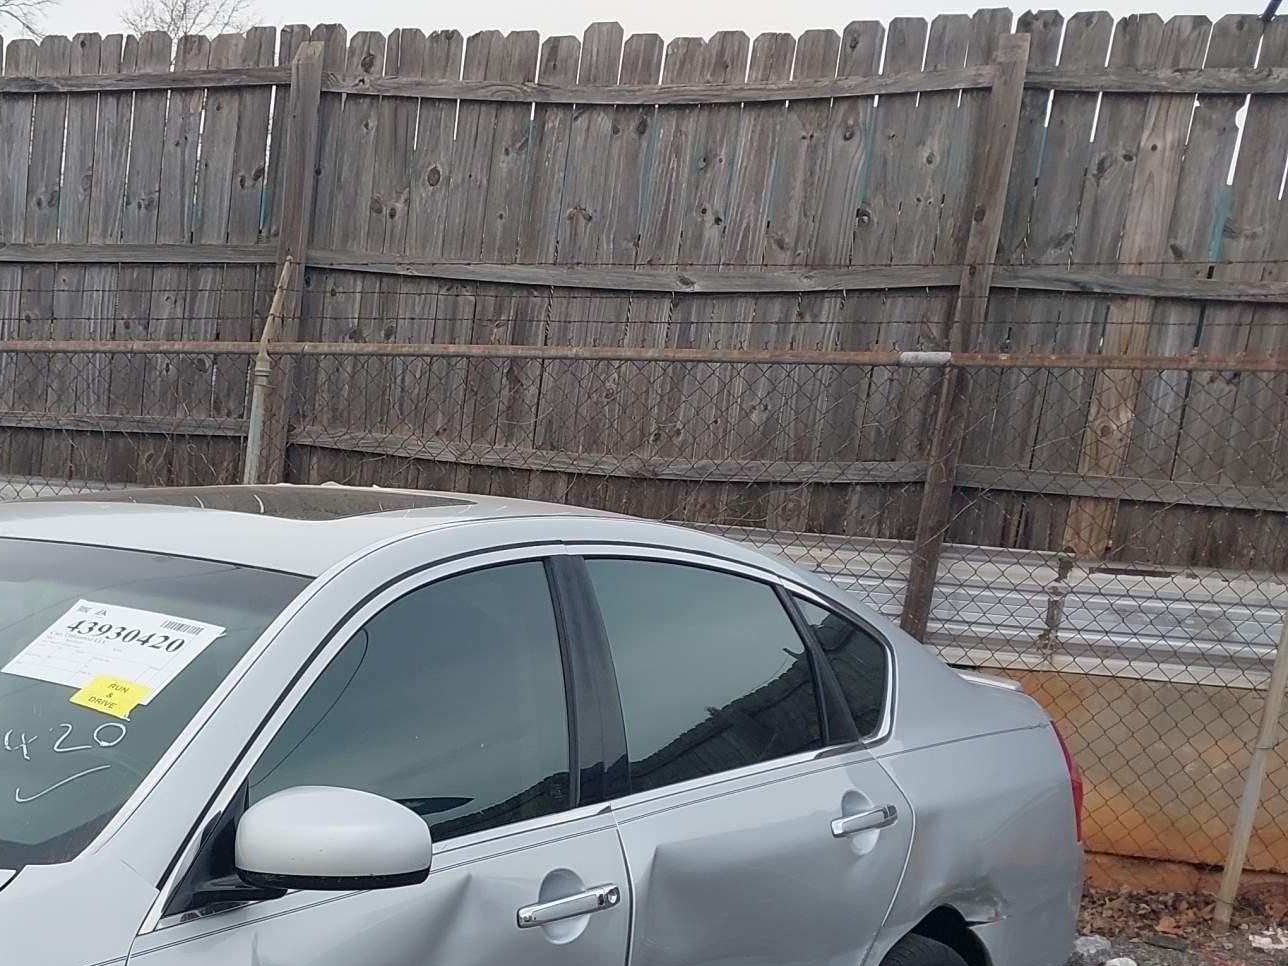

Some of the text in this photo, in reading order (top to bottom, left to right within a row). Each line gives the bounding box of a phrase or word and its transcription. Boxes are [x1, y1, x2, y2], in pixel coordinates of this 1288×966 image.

[67, 619, 186, 653] 43930420
[108, 682, 130, 694] RUN
[88, 696, 117, 710] DRIVE
